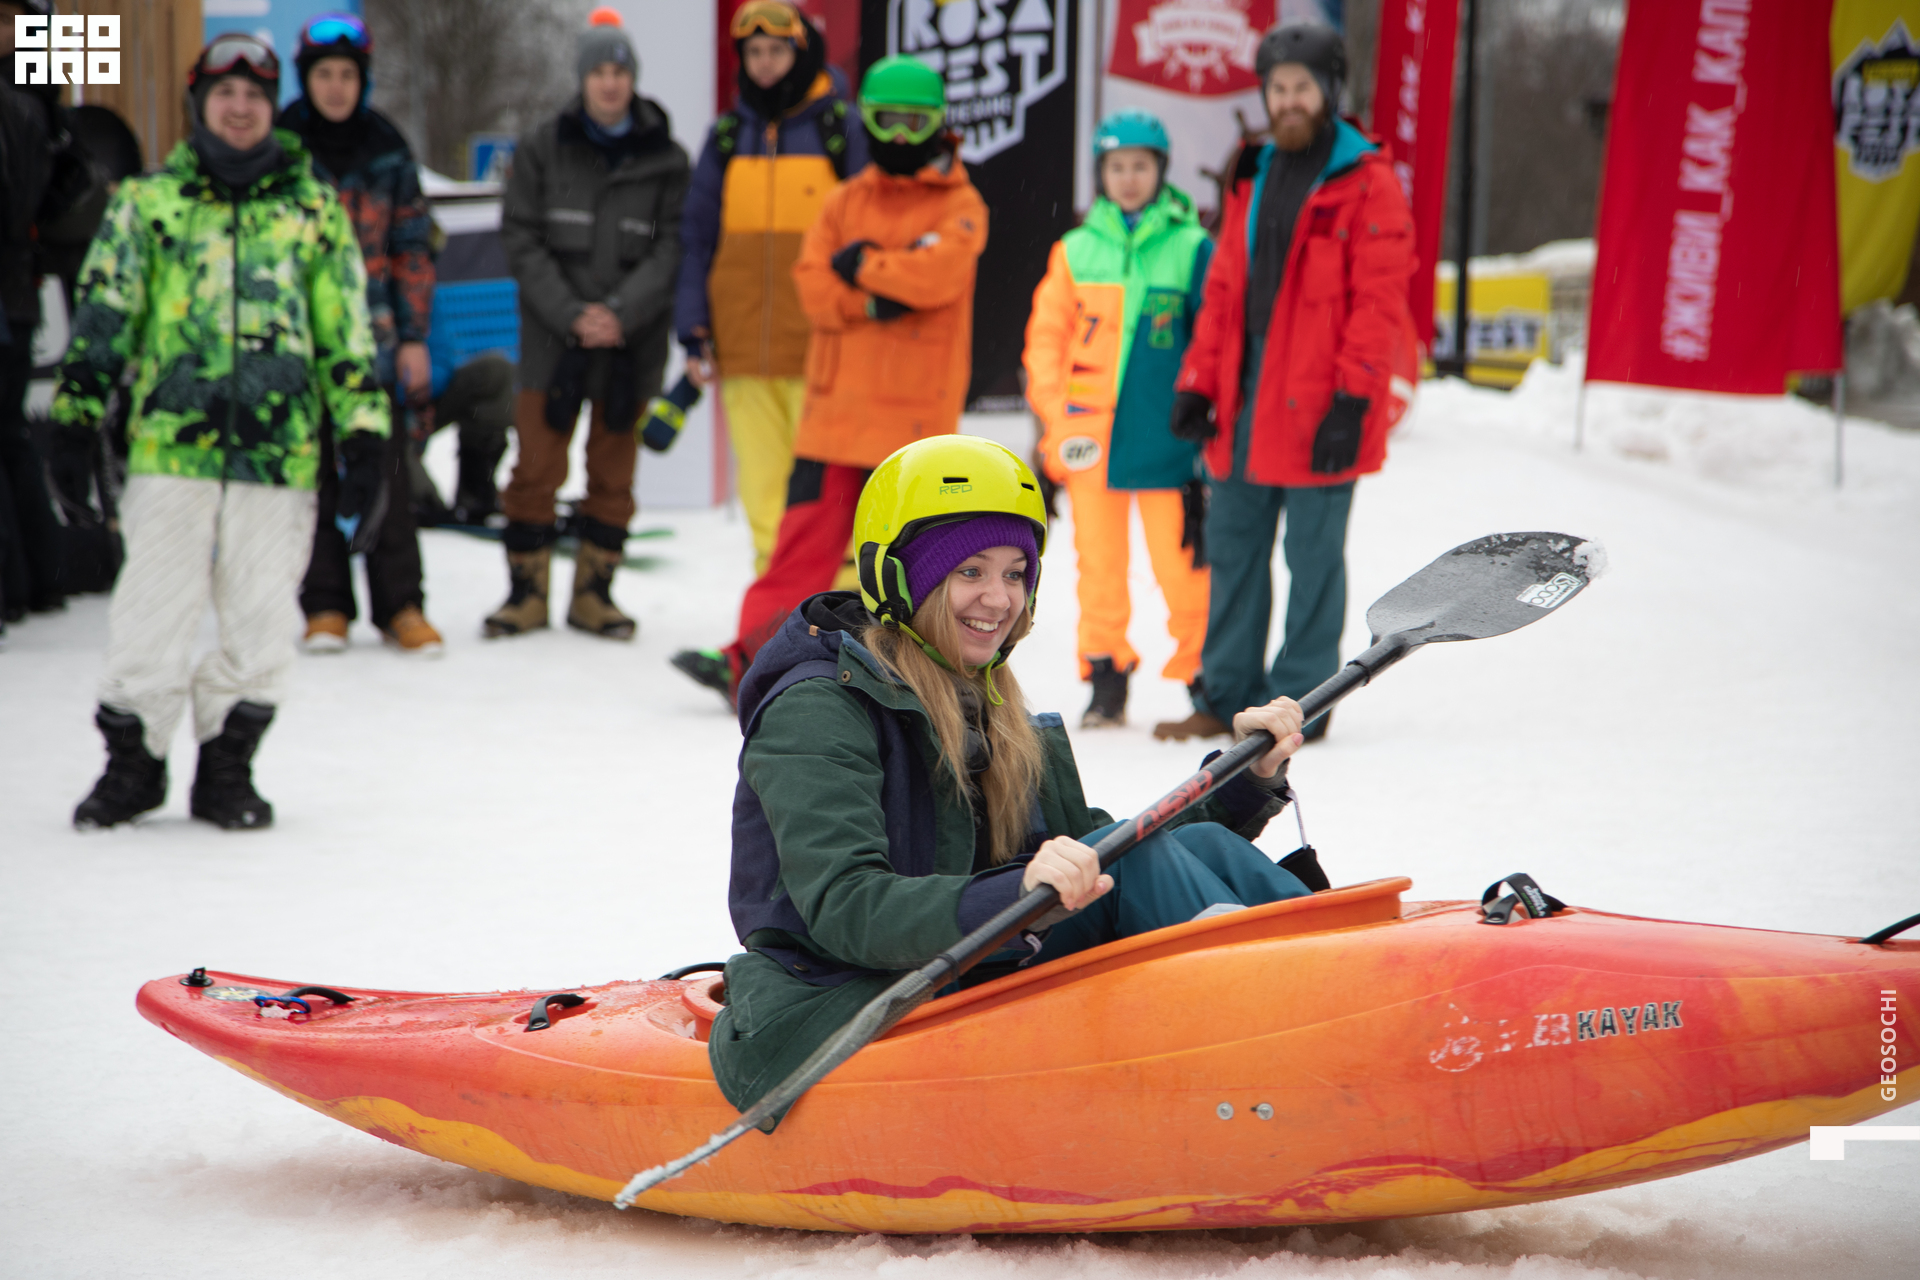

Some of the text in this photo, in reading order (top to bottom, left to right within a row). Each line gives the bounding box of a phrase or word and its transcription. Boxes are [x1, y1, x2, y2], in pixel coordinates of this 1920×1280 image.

[902, 0, 1053, 50] ROSA
[914, 34, 1049, 101] EST
[939, 484, 973, 496] RED
[1576, 999, 1684, 1042] KAYAK
